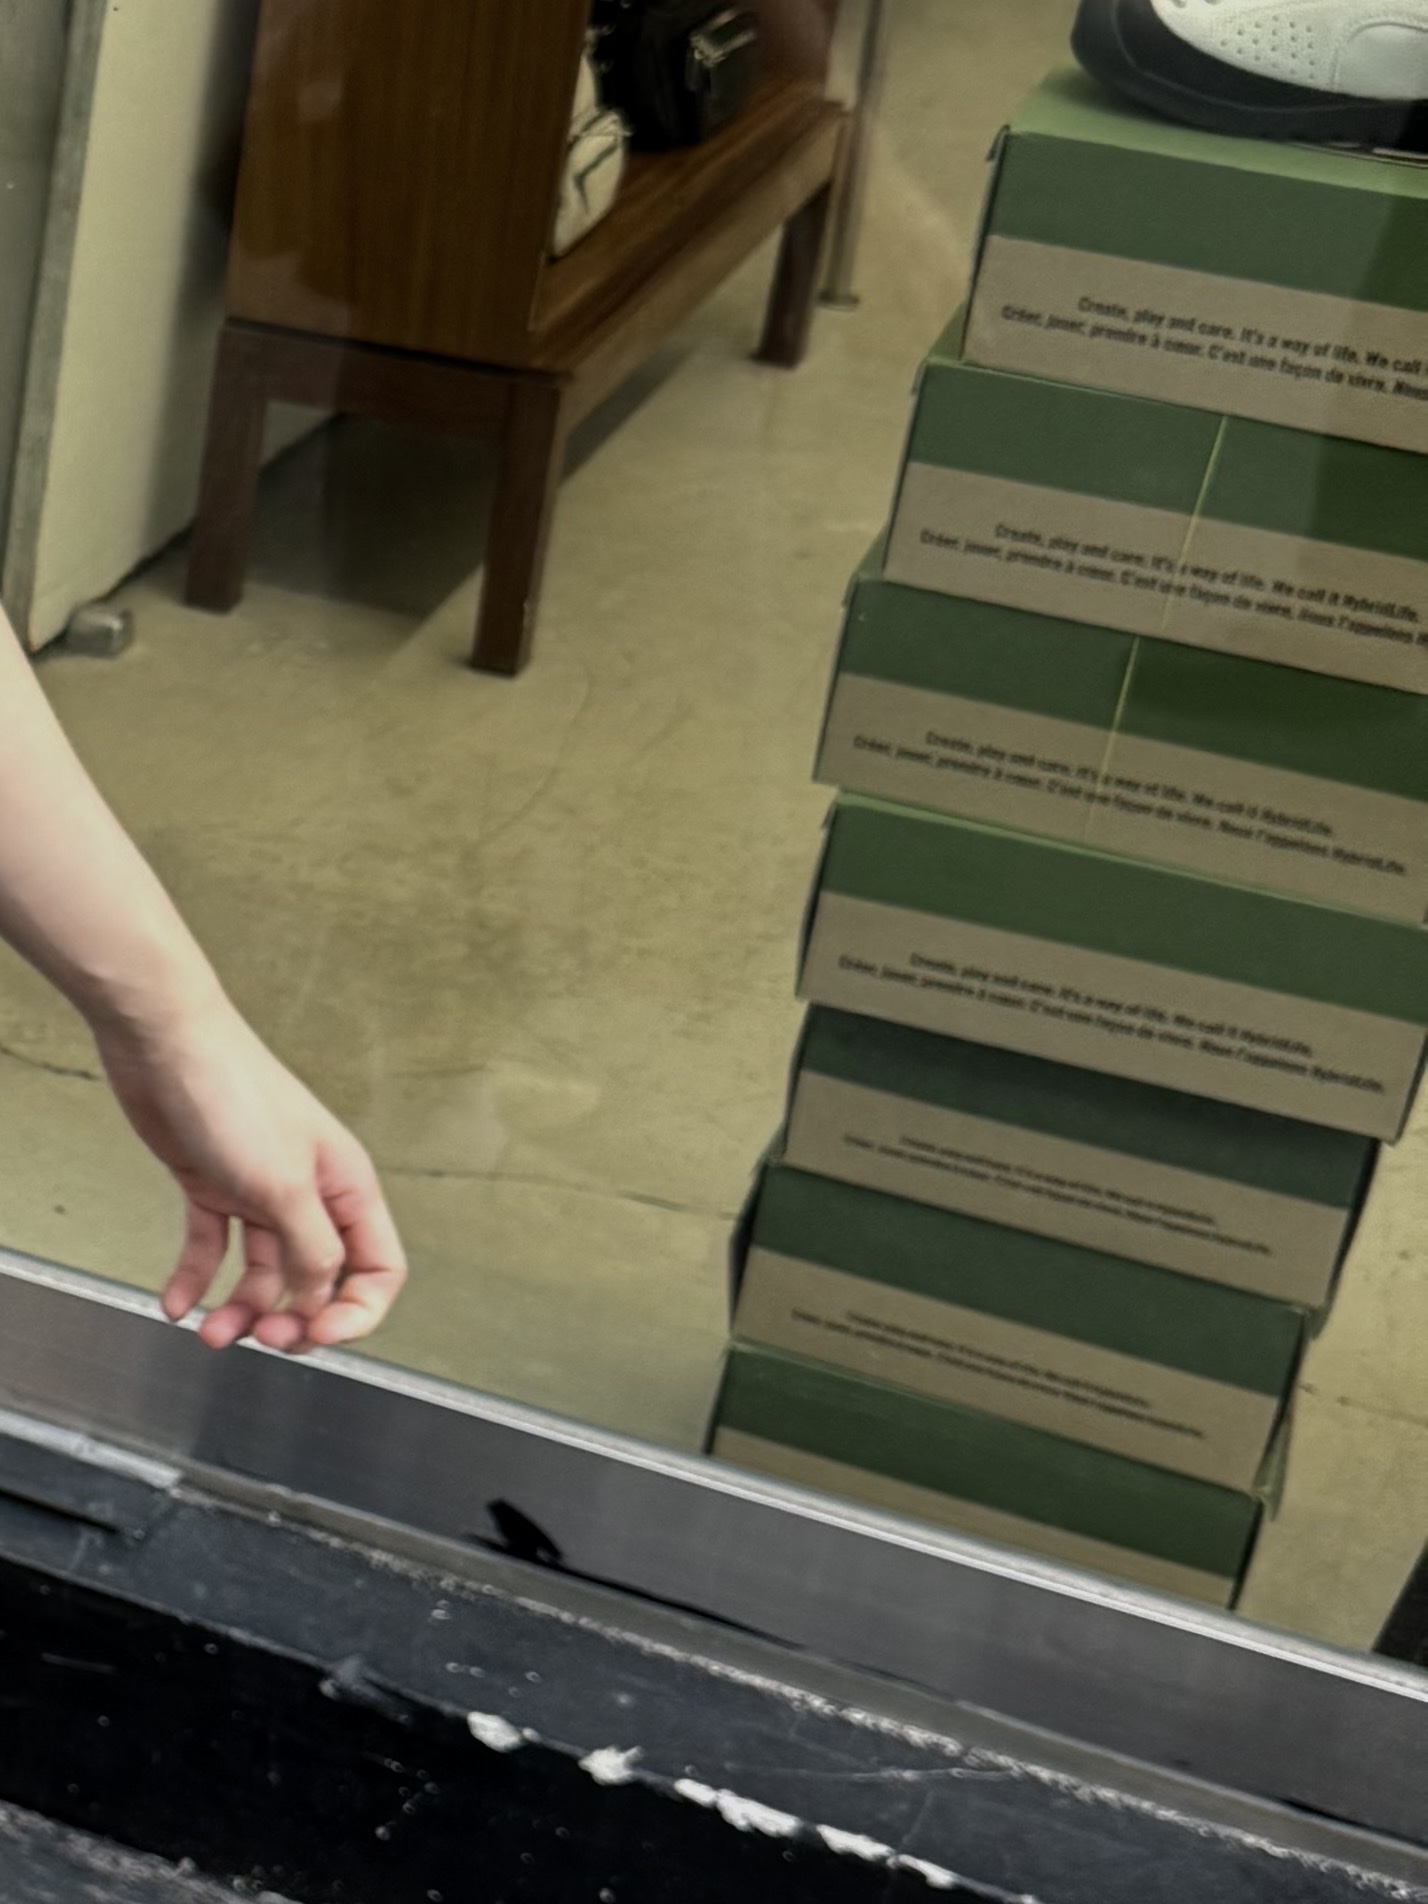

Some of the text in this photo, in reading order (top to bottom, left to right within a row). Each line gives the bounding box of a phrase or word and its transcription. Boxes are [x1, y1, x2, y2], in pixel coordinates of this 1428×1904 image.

[1132, 308, 1166, 328] play
[1168, 316, 1196, 332] and
[1281, 338, 1309, 356] way
[1313, 342, 1330, 357] of
[1366, 351, 1388, 368] We
[1081, 544, 1109, 558] and
[1191, 565, 1218, 583] way
